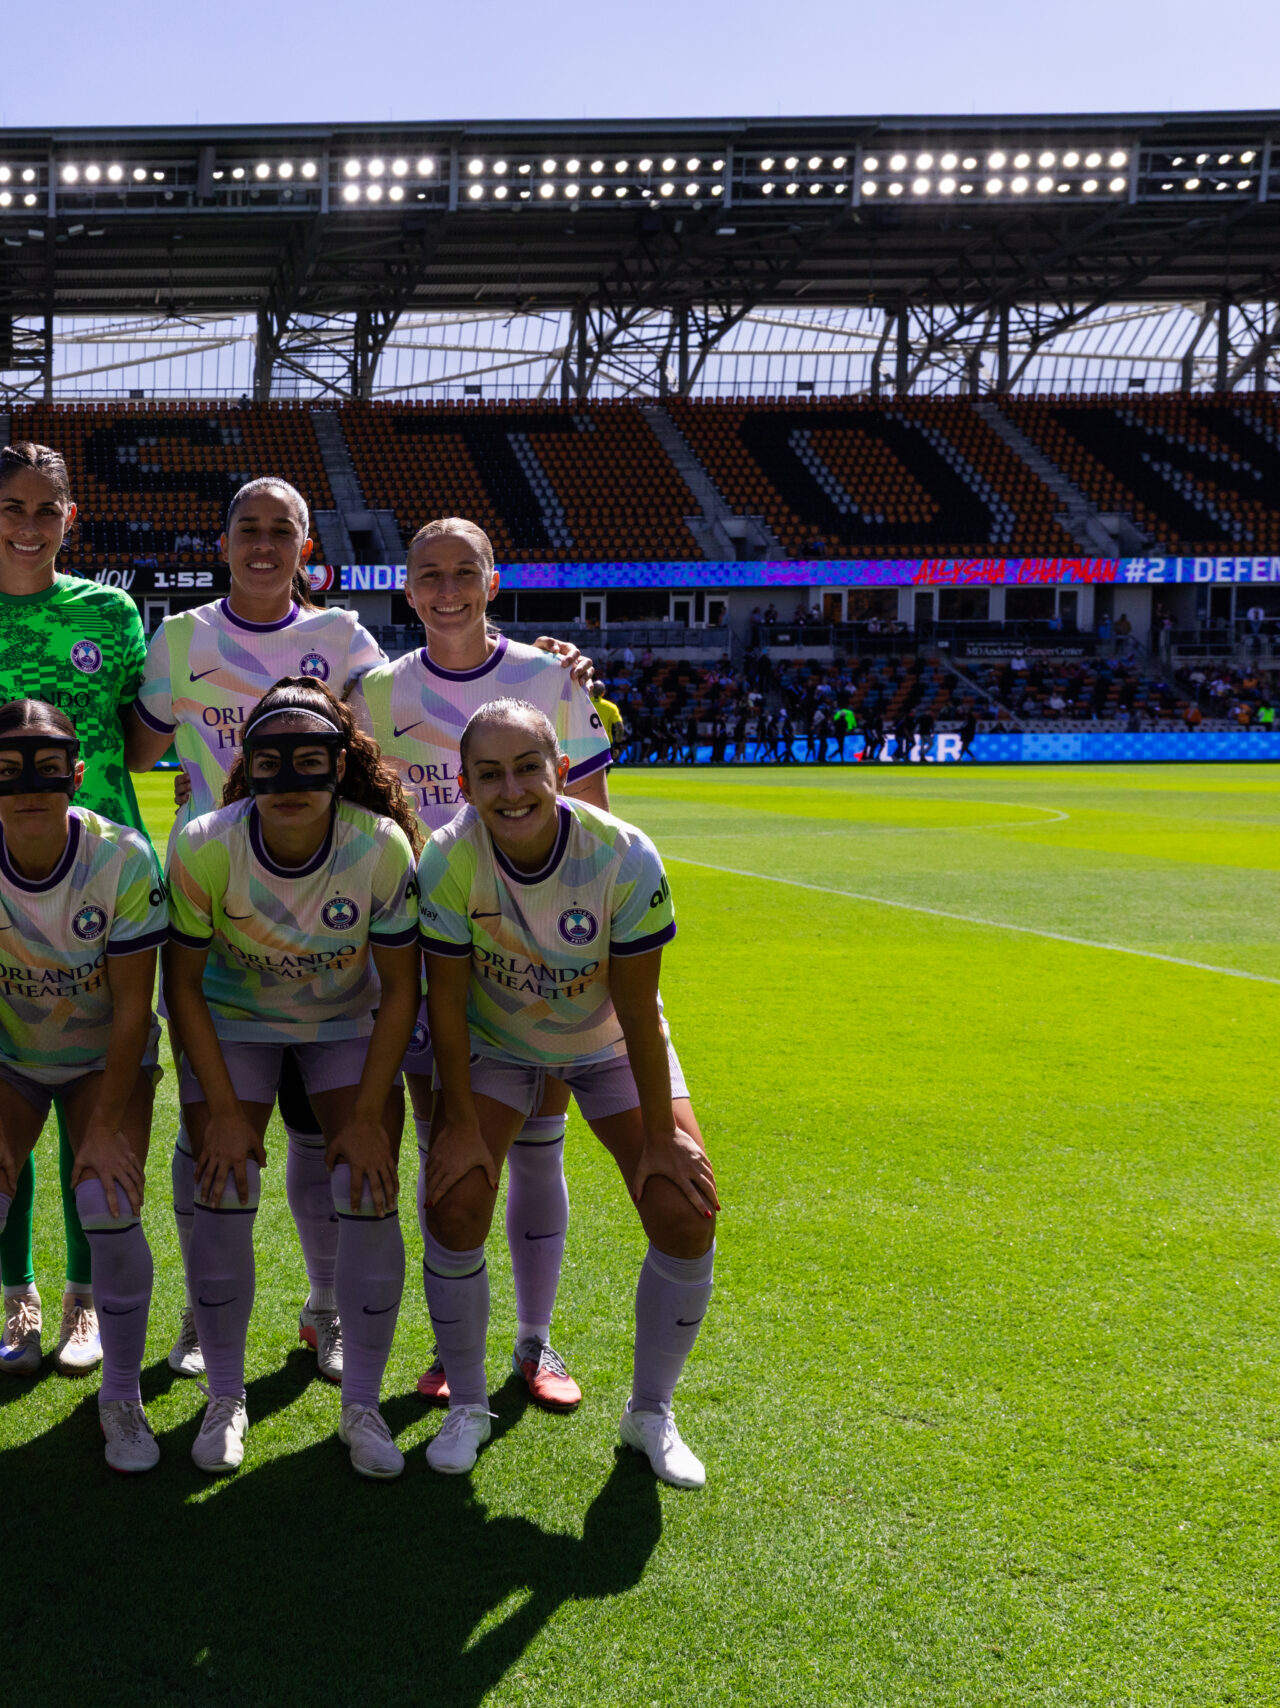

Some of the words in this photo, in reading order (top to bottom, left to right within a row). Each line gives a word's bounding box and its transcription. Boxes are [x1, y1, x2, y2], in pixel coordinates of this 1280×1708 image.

[153, 571, 214, 588] 1:52
[913, 559, 1007, 585] ALLYSHA
[1018, 558, 1120, 584] CHAPMAN
[1124, 557, 1165, 583] #2
[227, 943, 357, 967] ORLANDO
[472, 944, 599, 983] ORLANDO
[2, 974, 102, 998] HEALTH
[483, 964, 585, 1000] HEALTH
